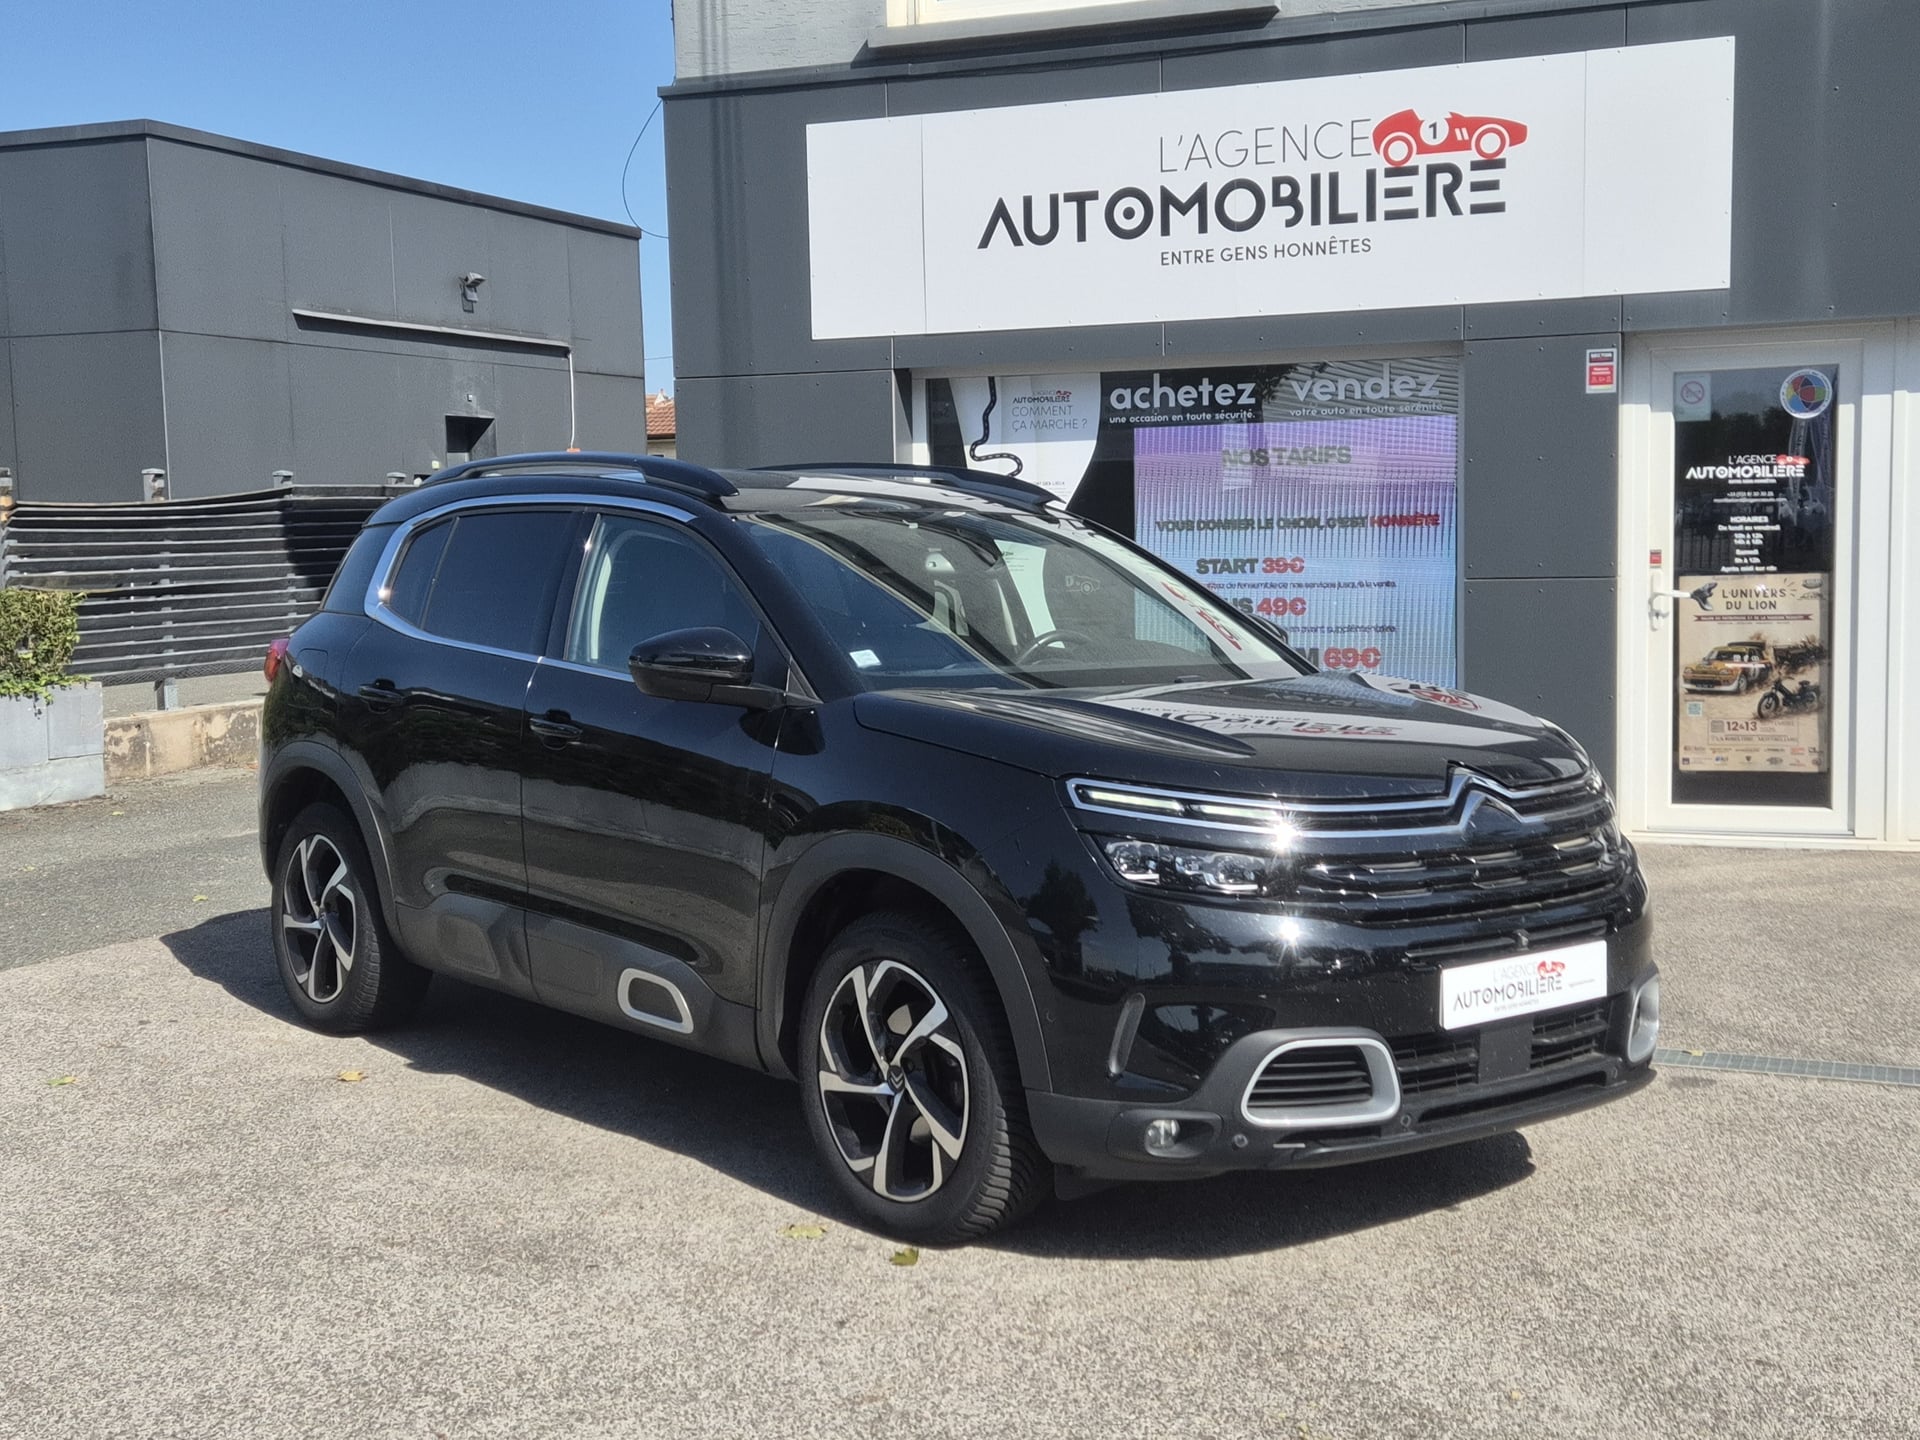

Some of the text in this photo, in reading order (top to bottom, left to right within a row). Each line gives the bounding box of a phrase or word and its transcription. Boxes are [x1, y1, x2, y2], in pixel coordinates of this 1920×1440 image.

[1160, 118, 1372, 173] L'AGENCE
[1160, 235, 1372, 266] ENTRE GENS HONNÊTES
[1109, 372, 1257, 410] achetez
[1289, 361, 1441, 402] vendez
[1011, 405, 1074, 417] COMMENT
[1109, 409, 1256, 424] une occasion en toute sécurité.
[1289, 407, 1318, 417] votre
[1320, 406, 1346, 416] auto
[1349, 407, 1363, 415] en
[1365, 405, 1396, 414] toute
[1011, 420, 1027, 432] ÇA
[1029, 418, 1079, 430] MARCHE
[1222, 445, 1352, 467] NOS TARIFS
[1728, 454, 1777, 465] L'AGENCE
[1196, 556, 1305, 575] START 39€
[1256, 596, 1307, 616] 49€
[1725, 600, 1777, 610] DU LION
[1323, 646, 1382, 669] 69€
